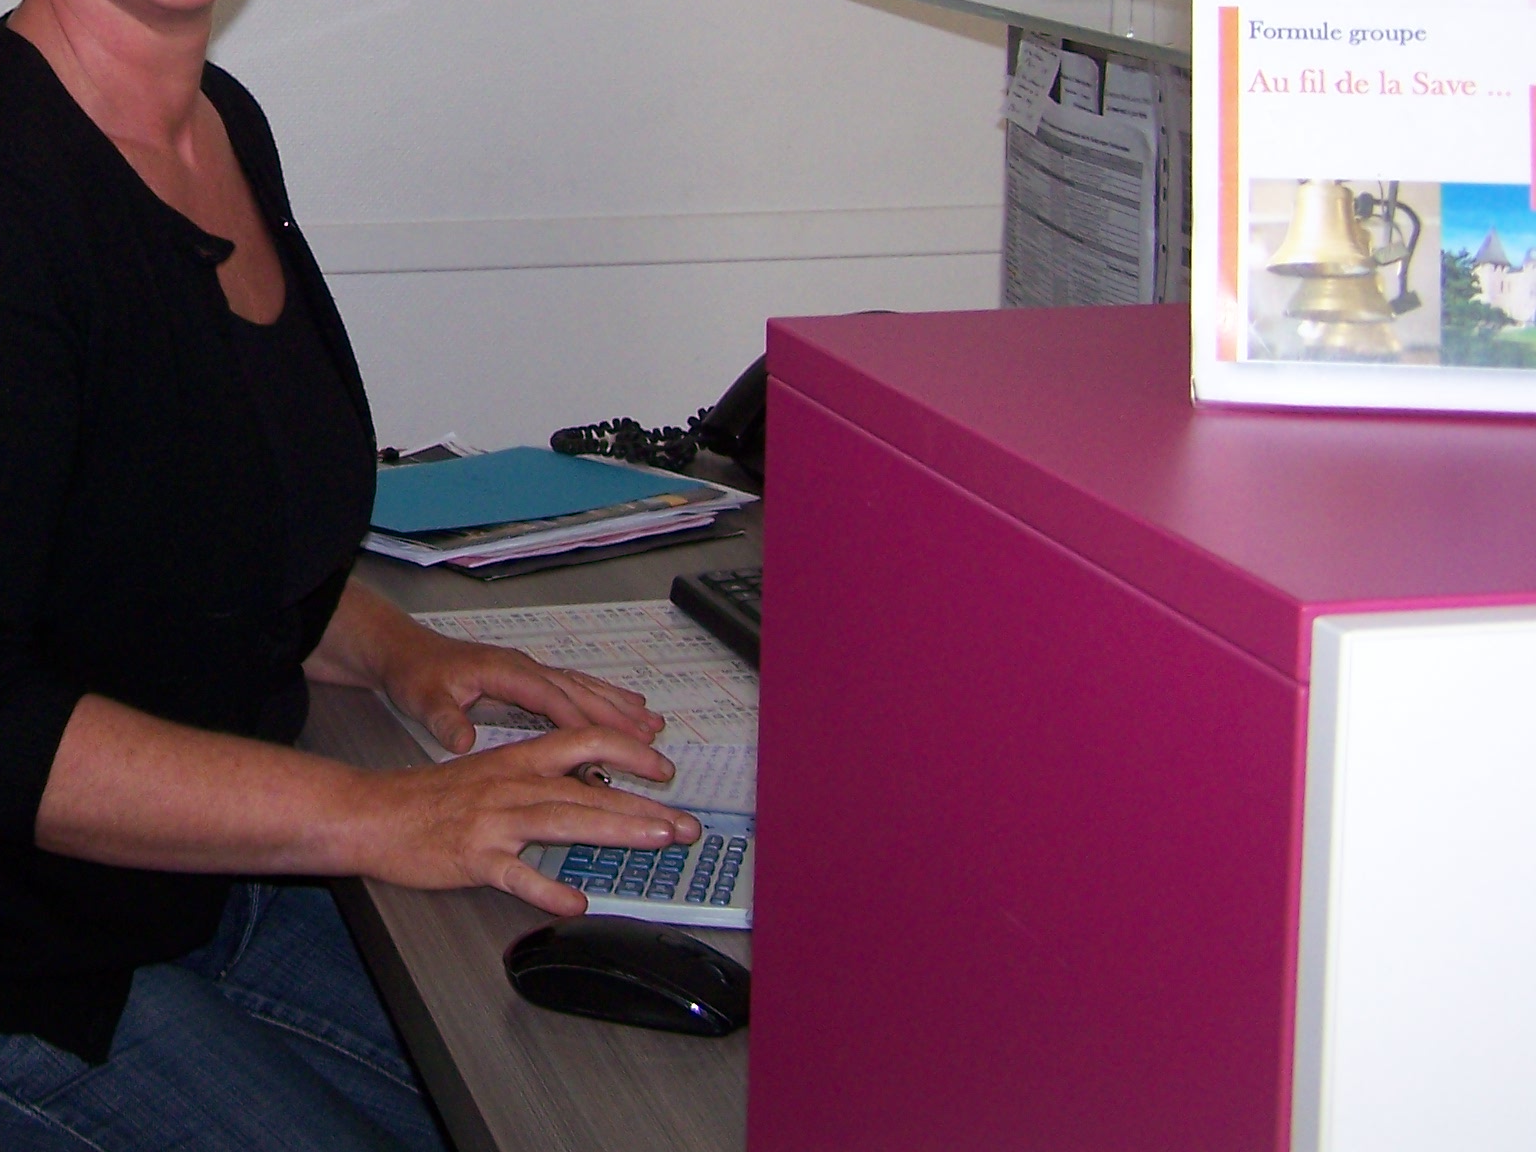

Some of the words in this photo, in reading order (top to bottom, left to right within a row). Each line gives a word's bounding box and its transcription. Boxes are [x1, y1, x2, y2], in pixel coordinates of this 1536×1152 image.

[1249, 20, 1343, 41] Formule
[1349, 26, 1427, 45] groupe
[1249, 69, 1290, 94] Au
[1299, 69, 1326, 94] fil
[1335, 70, 1369, 95] de
[1379, 70, 1402, 95] la
[1412, 71, 1476, 96] Save
